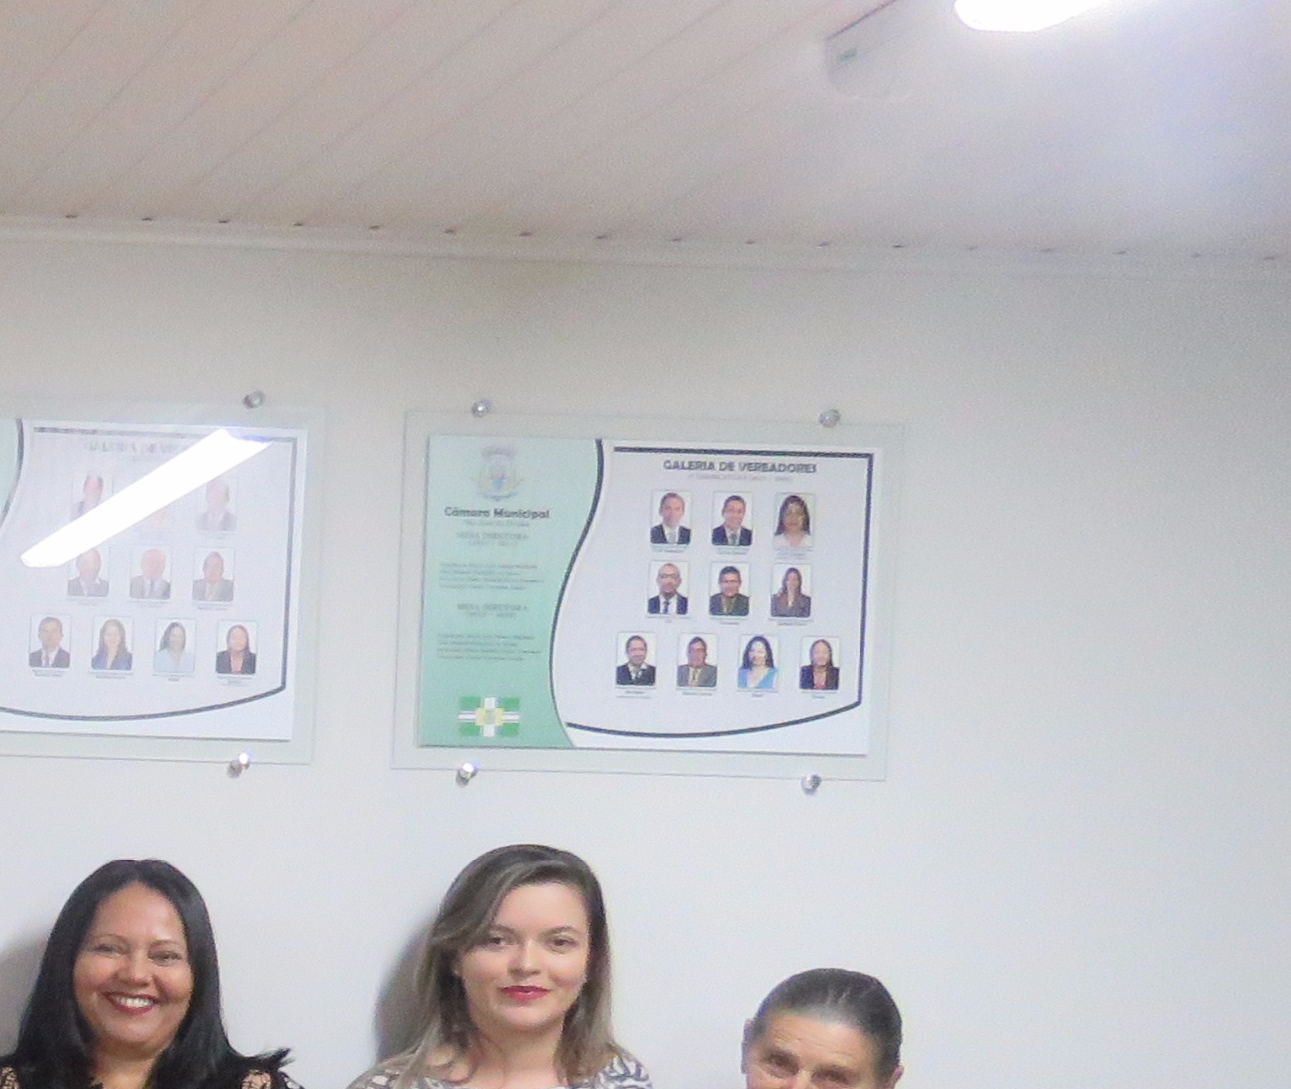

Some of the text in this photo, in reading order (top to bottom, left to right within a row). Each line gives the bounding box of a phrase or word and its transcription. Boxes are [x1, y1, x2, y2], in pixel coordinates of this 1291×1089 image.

[663, 460, 817, 474] GALERIA DE VEREADORES
[444, 507, 550, 519] Câmara Municipal
